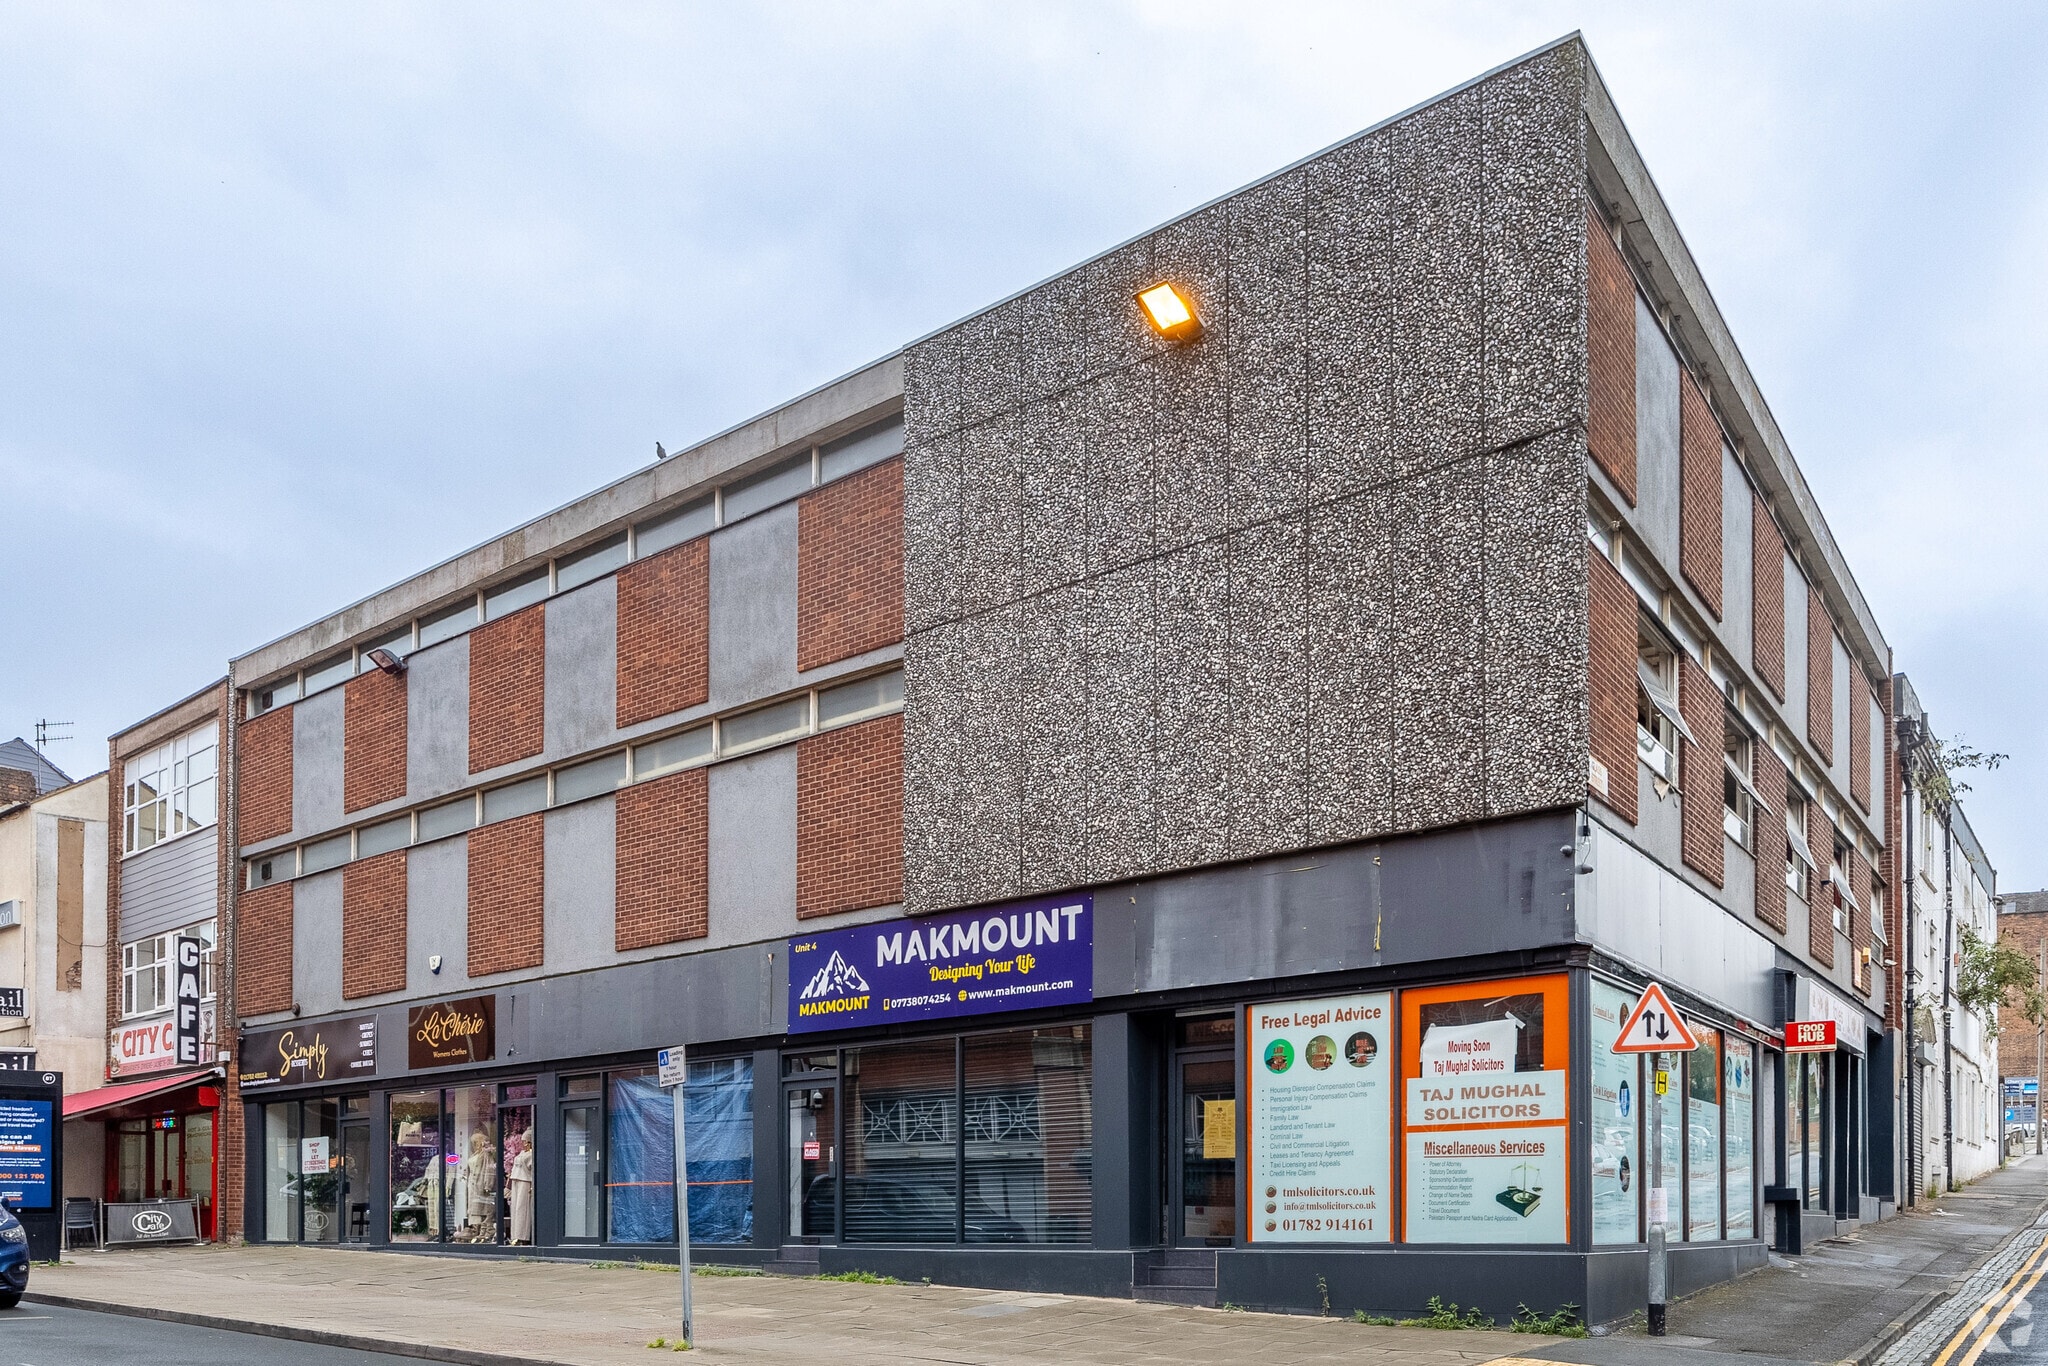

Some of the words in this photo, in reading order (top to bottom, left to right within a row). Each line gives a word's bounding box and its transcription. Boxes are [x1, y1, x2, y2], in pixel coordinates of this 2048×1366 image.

[876, 904, 1084, 967] MAKMOUNT
[794, 943, 811, 953] Unit
[811, 942, 817, 951] 4
[929, 960, 984, 984] Designing
[985, 958, 1012, 974] Your
[1014, 953, 1037, 974] Life
[890, 992, 951, 1009] 07738074254
[968, 978, 1074, 1000] www.makmount.com
[178, 942, 199, 1061] CAFE
[799, 995, 871, 1017] MAKMOUNT
[1261, 1015, 1291, 1030] Free
[1294, 1009, 1331, 1029] Legal
[1334, 1006, 1382, 1023] Advice
[416, 1011, 441, 1048] La
[1797, 1023, 1826, 1033] FOOD
[122, 1025, 159, 1058] CITY
[1797, 1031, 1826, 1043] HUB
[1447, 1040, 1472, 1055] Moving
[1473, 1039, 1491, 1052] Soon
[278, 1031, 329, 1079] Simply
[1433, 1061, 1445, 1075] Taj
[1445, 1060, 1470, 1075] Mughal
[1471, 1058, 1505, 1072] Solicitors
[1269, 1086, 1292, 1094] Housing
[1292, 1085, 1315, 1093] Disrepair
[1316, 1082, 1356, 1091] Compensation
[1356, 1080, 1376, 1088] Claims
[1657, 1072, 1668, 1093] H
[1293, 1095, 1309, 1103] Injury
[1309, 1093, 1348, 1102] Compensation
[1348, 1090, 1368, 1098] Claims
[1419, 1087, 1454, 1102] TAJ
[1460, 1083, 1546, 1100] MUGHAL
[1269, 1105, 1300, 1113] Immigration
[1269, 1114, 1287, 1122] Family
[1324, 1121, 1336, 1129] Law
[1291, 1132, 1303, 1140] Law
[1293, 1141, 1325, 1149] Commercial
[1325, 1140, 1350, 1149] Litigation
[1424, 1141, 1496, 1155] Miscellaneous
[1499, 1139, 1546, 1154] Services
[1300, 1150, 1324, 1159] Tenancy
[1324, 1149, 1354, 1158] Agreement
[1281, 1160, 1307, 1169] Licensing
[1318, 1159, 1341, 1168] Appeals
[1269, 1169, 1286, 1177] Credit
[1282, 1185, 1376, 1197] tmlsolicitors.co.uk
[1282, 1218, 1322, 1231] 01782
[1325, 1218, 1374, 1231] 914161
